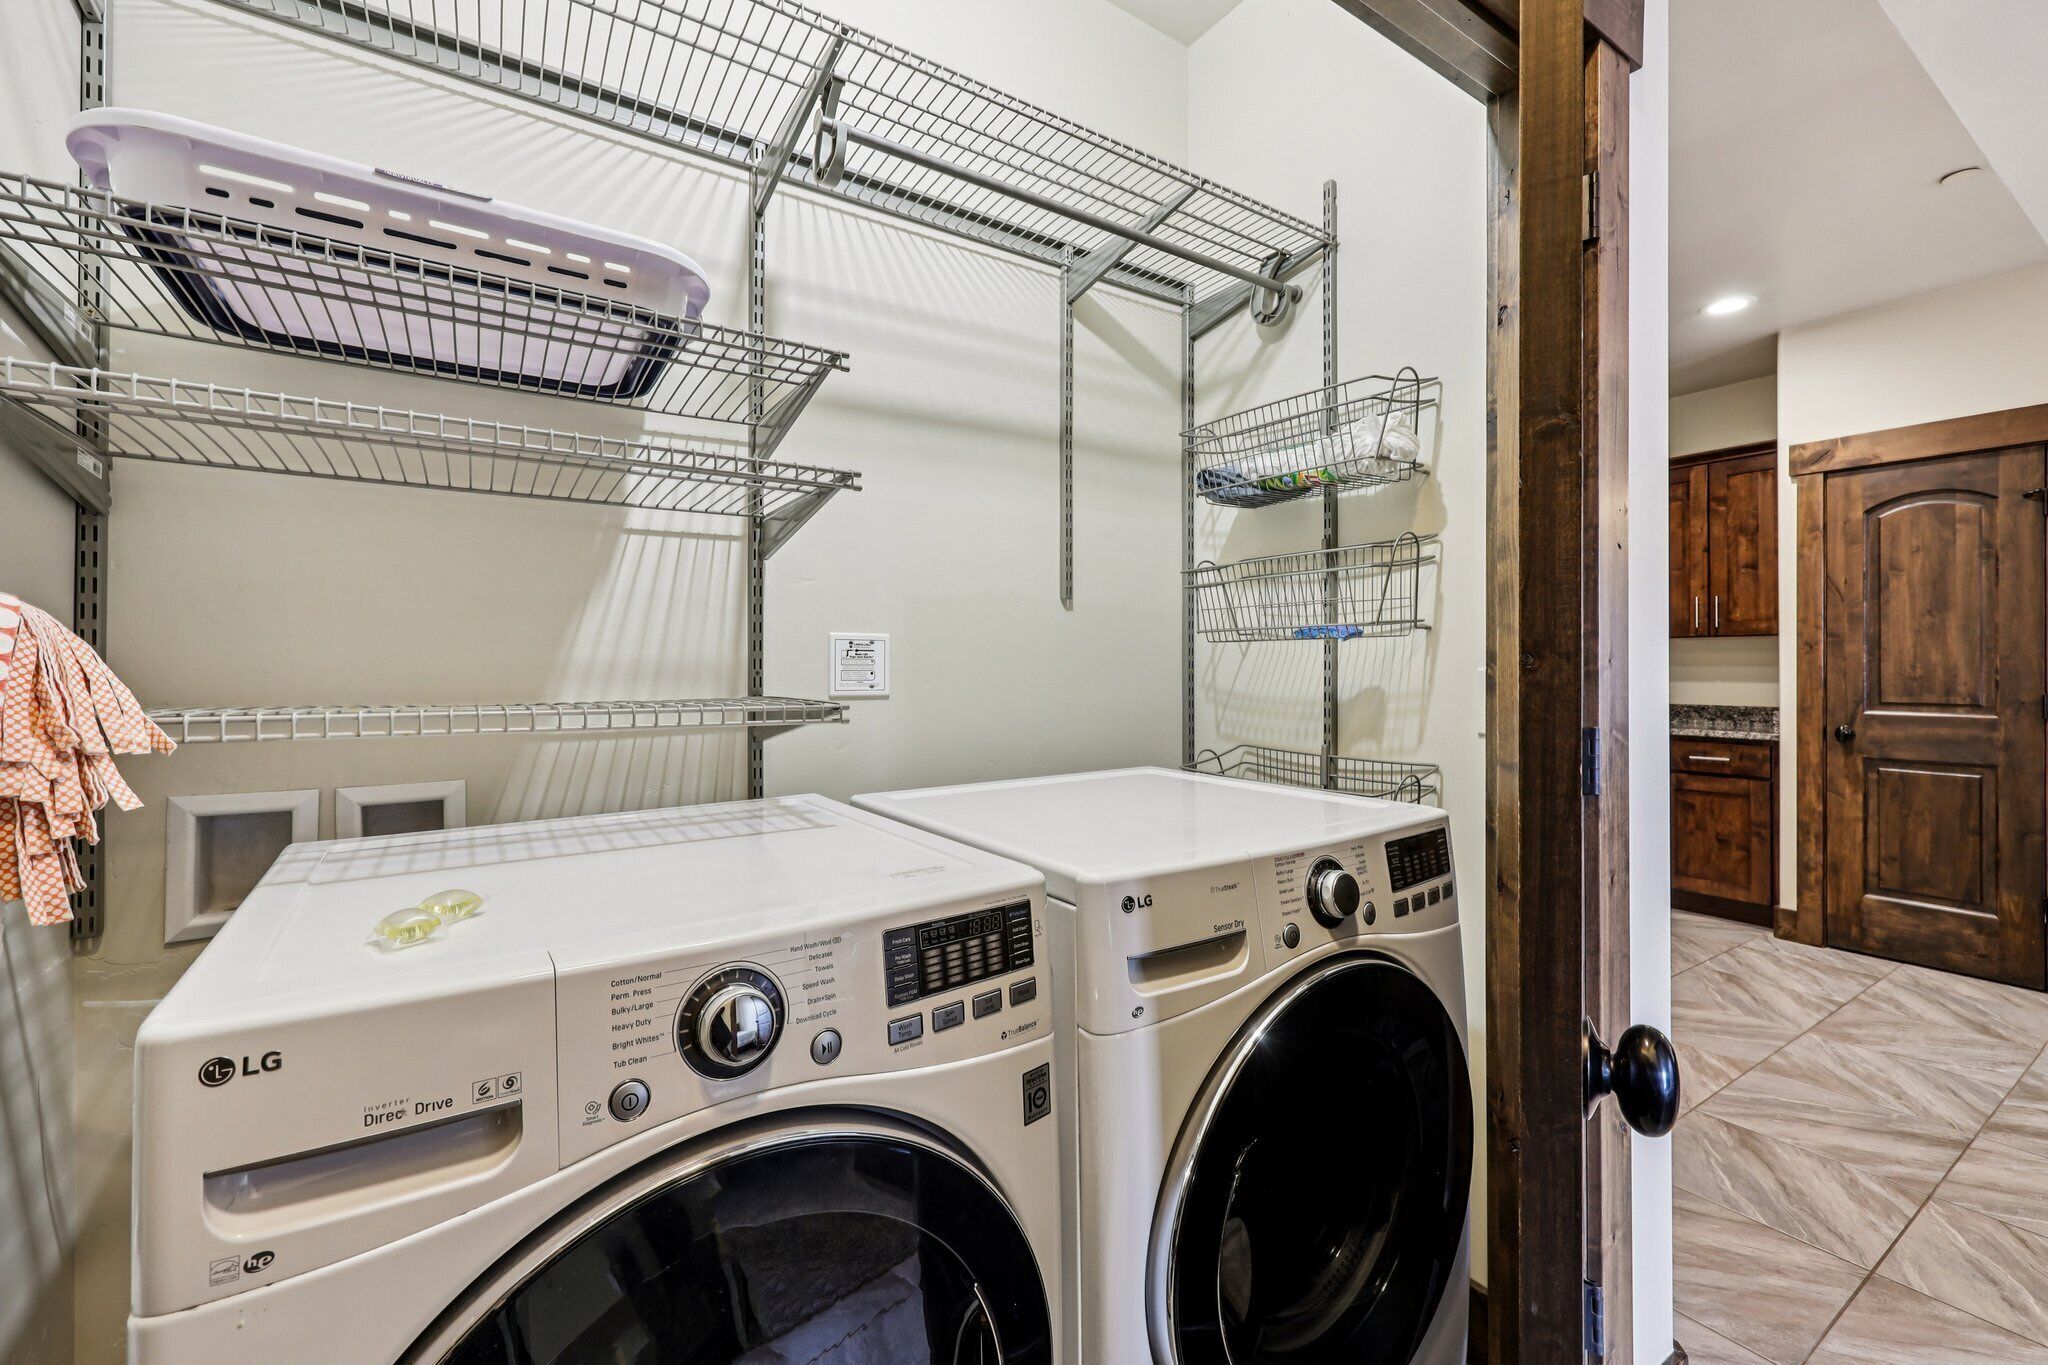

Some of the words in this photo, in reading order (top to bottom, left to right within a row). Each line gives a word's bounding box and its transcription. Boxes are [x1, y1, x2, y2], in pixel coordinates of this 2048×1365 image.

[1137, 895, 1153, 908] LG
[1213, 922, 1233, 933] Sensor
[1234, 919, 1245, 928] Dry
[790, 944, 803, 953] Hand
[804, 938, 832, 950] Wash/Wool
[808, 951, 833, 961] Delicates
[815, 963, 834, 972] Towels
[610, 972, 662, 987] Cotton/Normal
[802, 981, 819, 990] Speed
[820, 977, 835, 986] Wash
[632, 988, 652, 997] Press
[611, 1002, 654, 1015] Bulky/Large
[944, 1010, 955, 1018] Spin
[796, 1012, 822, 1024] Download
[823, 1009, 837, 1018] Cycle
[942, 1016, 957, 1025] Speed
[612, 1022, 634, 1032] Heavy
[635, 1019, 652, 1027] Duty
[898, 1022, 912, 1030] Wash
[898, 1030, 912, 1038] Temp
[612, 1041, 634, 1051] Bright
[900, 1043, 909, 1051] Cold
[242, 1051, 282, 1077] LG
[614, 1060, 627, 1068] Tub
[628, 1056, 647, 1065] Clean
[363, 1097, 410, 1113] Inverter
[415, 1097, 453, 1116] Drive
[1027, 1087, 1047, 1113] 10
